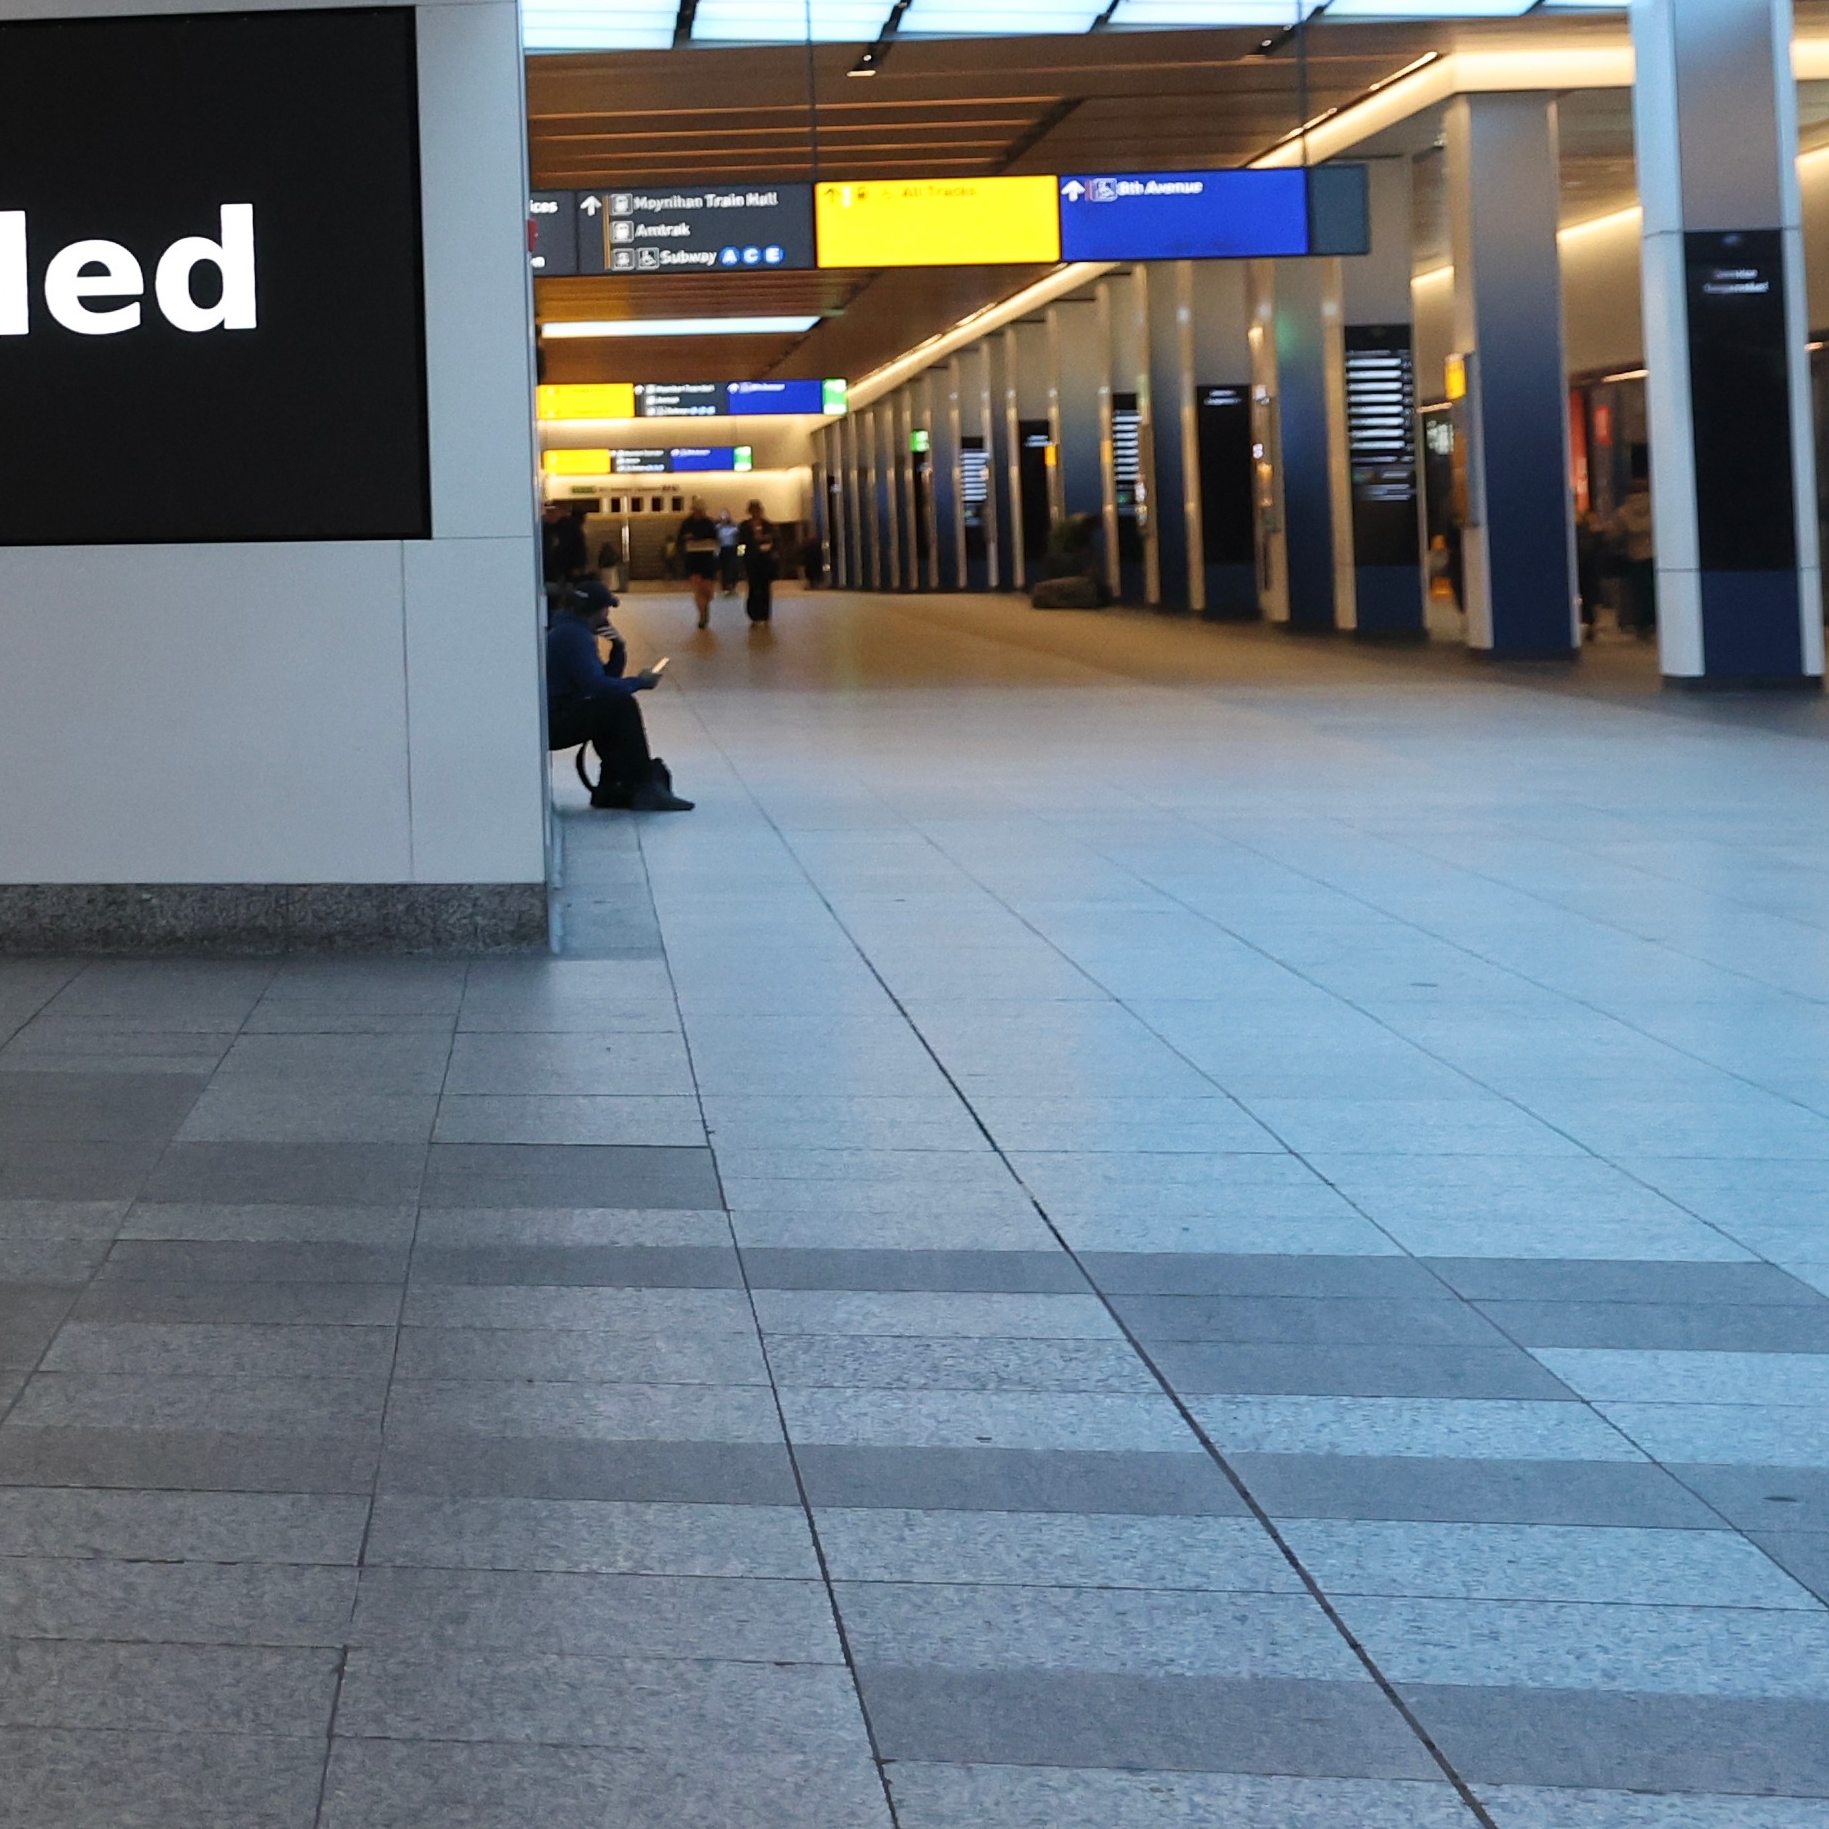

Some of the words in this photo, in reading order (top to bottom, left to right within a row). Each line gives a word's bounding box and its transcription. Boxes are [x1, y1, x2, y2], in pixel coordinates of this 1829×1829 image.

[1144, 180, 1204, 196] Avenue
[705, 193, 744, 208] Train
[746, 191, 779, 206] Hall
[635, 222, 691, 238] Amtrak
[660, 249, 718, 266] Subway
